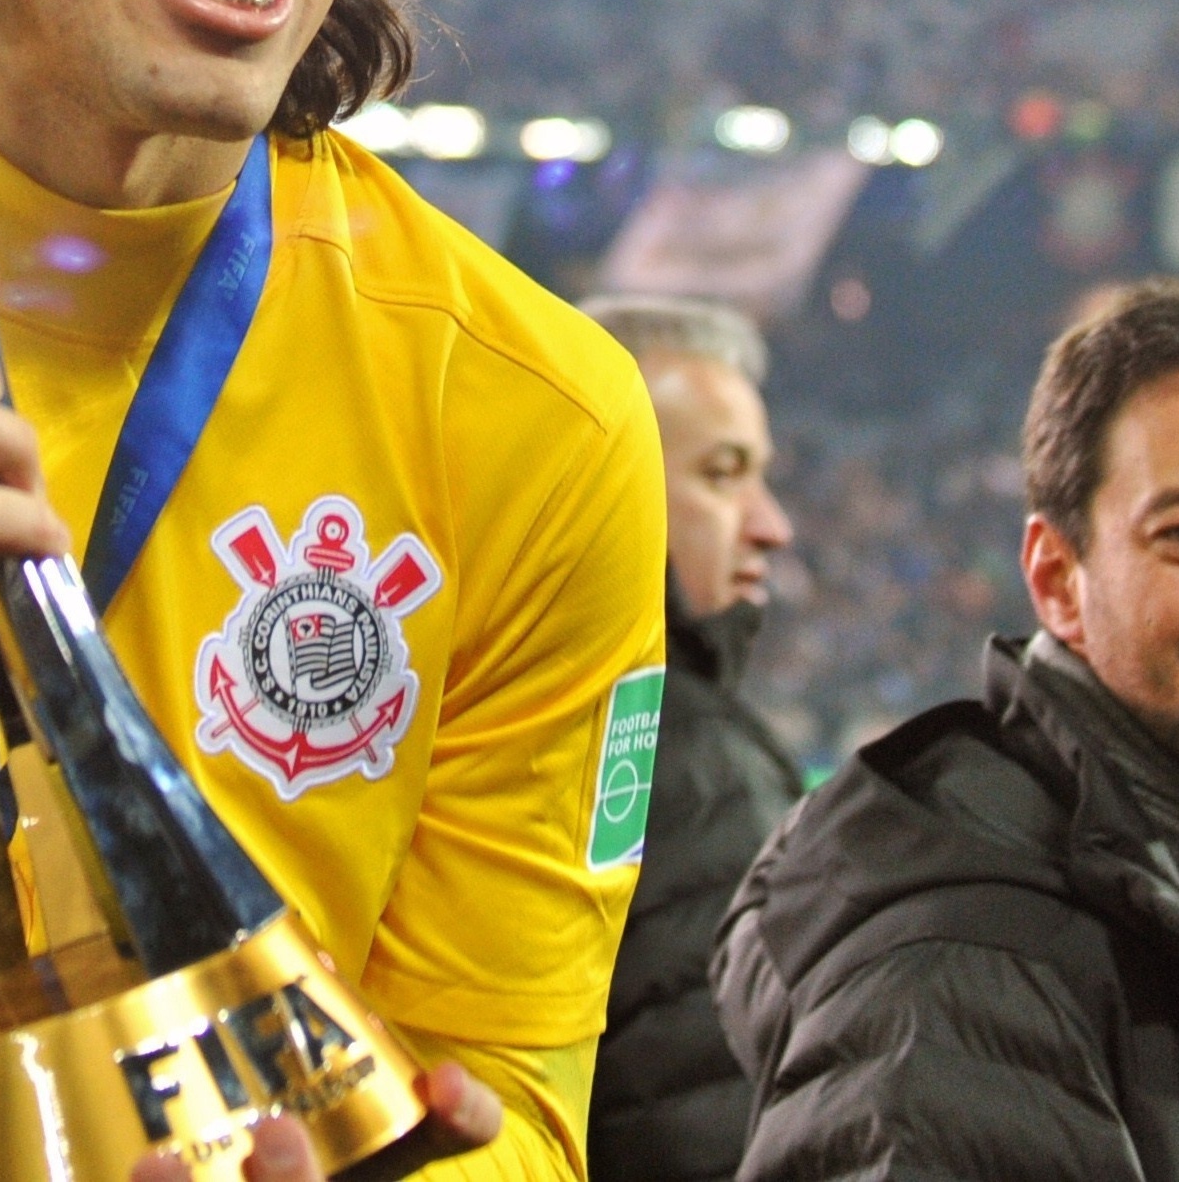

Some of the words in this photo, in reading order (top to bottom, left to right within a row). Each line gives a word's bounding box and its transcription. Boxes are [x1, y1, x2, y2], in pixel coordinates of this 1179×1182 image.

[219, 232, 256, 290] FIFA
[111, 467, 149, 525] FIFA
[254, 584, 359, 651] CORINTHIANS
[344, 611, 379, 702] PAULISTA
[287, 698, 328, 717] 1910
[611, 710, 660, 738] FOOTBA
[608, 736, 631, 758] FOR
[633, 731, 655, 751] HO
[119, 981, 357, 1142] FIFA
